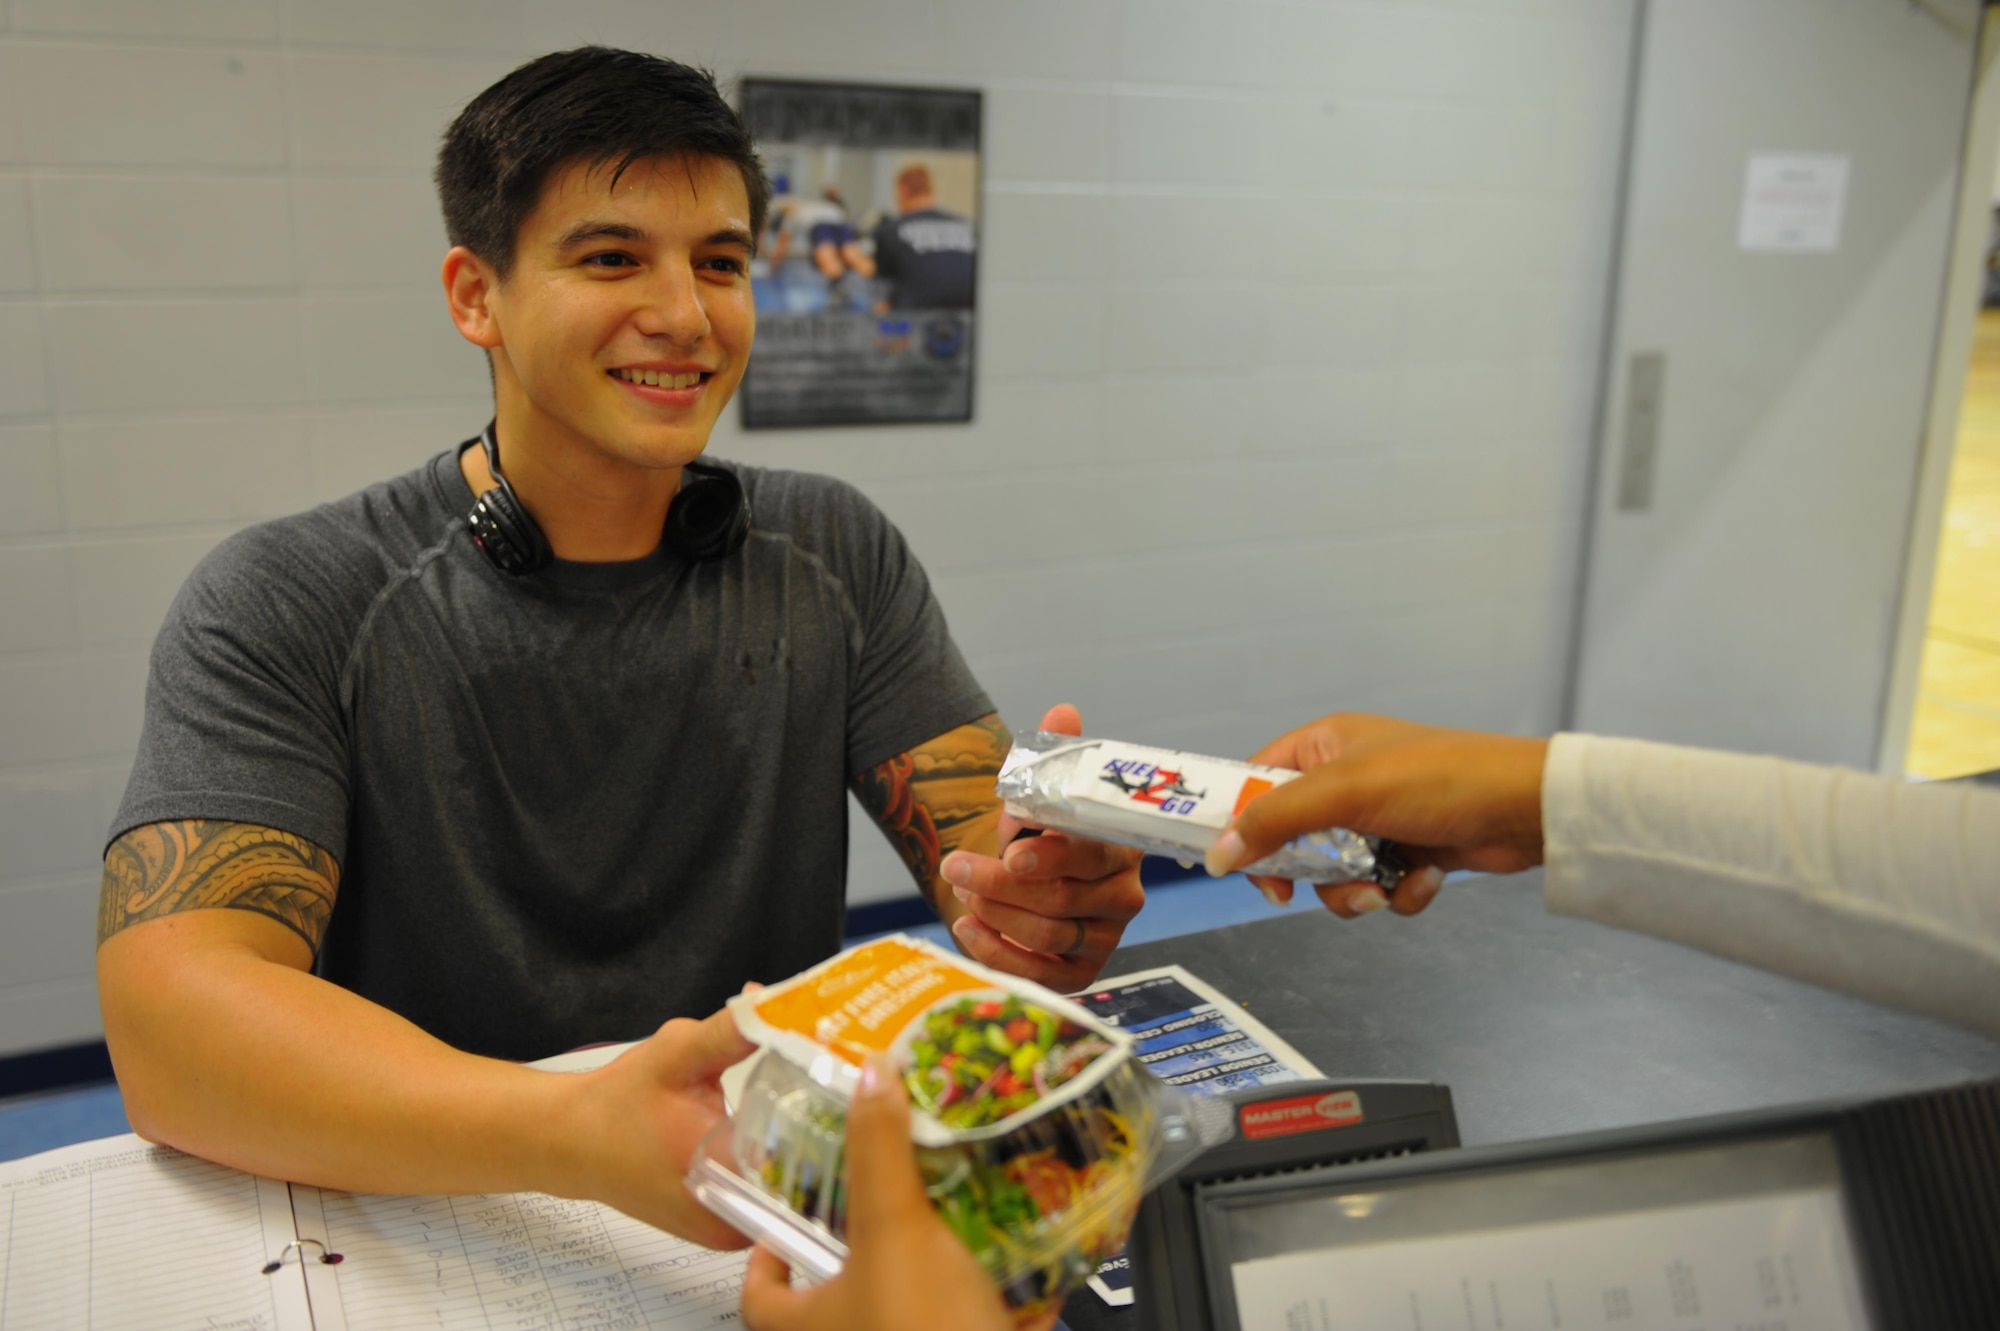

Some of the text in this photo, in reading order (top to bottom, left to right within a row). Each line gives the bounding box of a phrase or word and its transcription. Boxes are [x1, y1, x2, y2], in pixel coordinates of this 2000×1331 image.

[1103, 759, 1160, 779] FUEL
[1159, 796, 1197, 815] GO
[1163, 1009, 1224, 1032] CLOSING
[1193, 1032, 1246, 1051] SENIOR
[1218, 1055, 1274, 1074] SENIOR
[1245, 1100, 1353, 1125] MASTER VIEW
